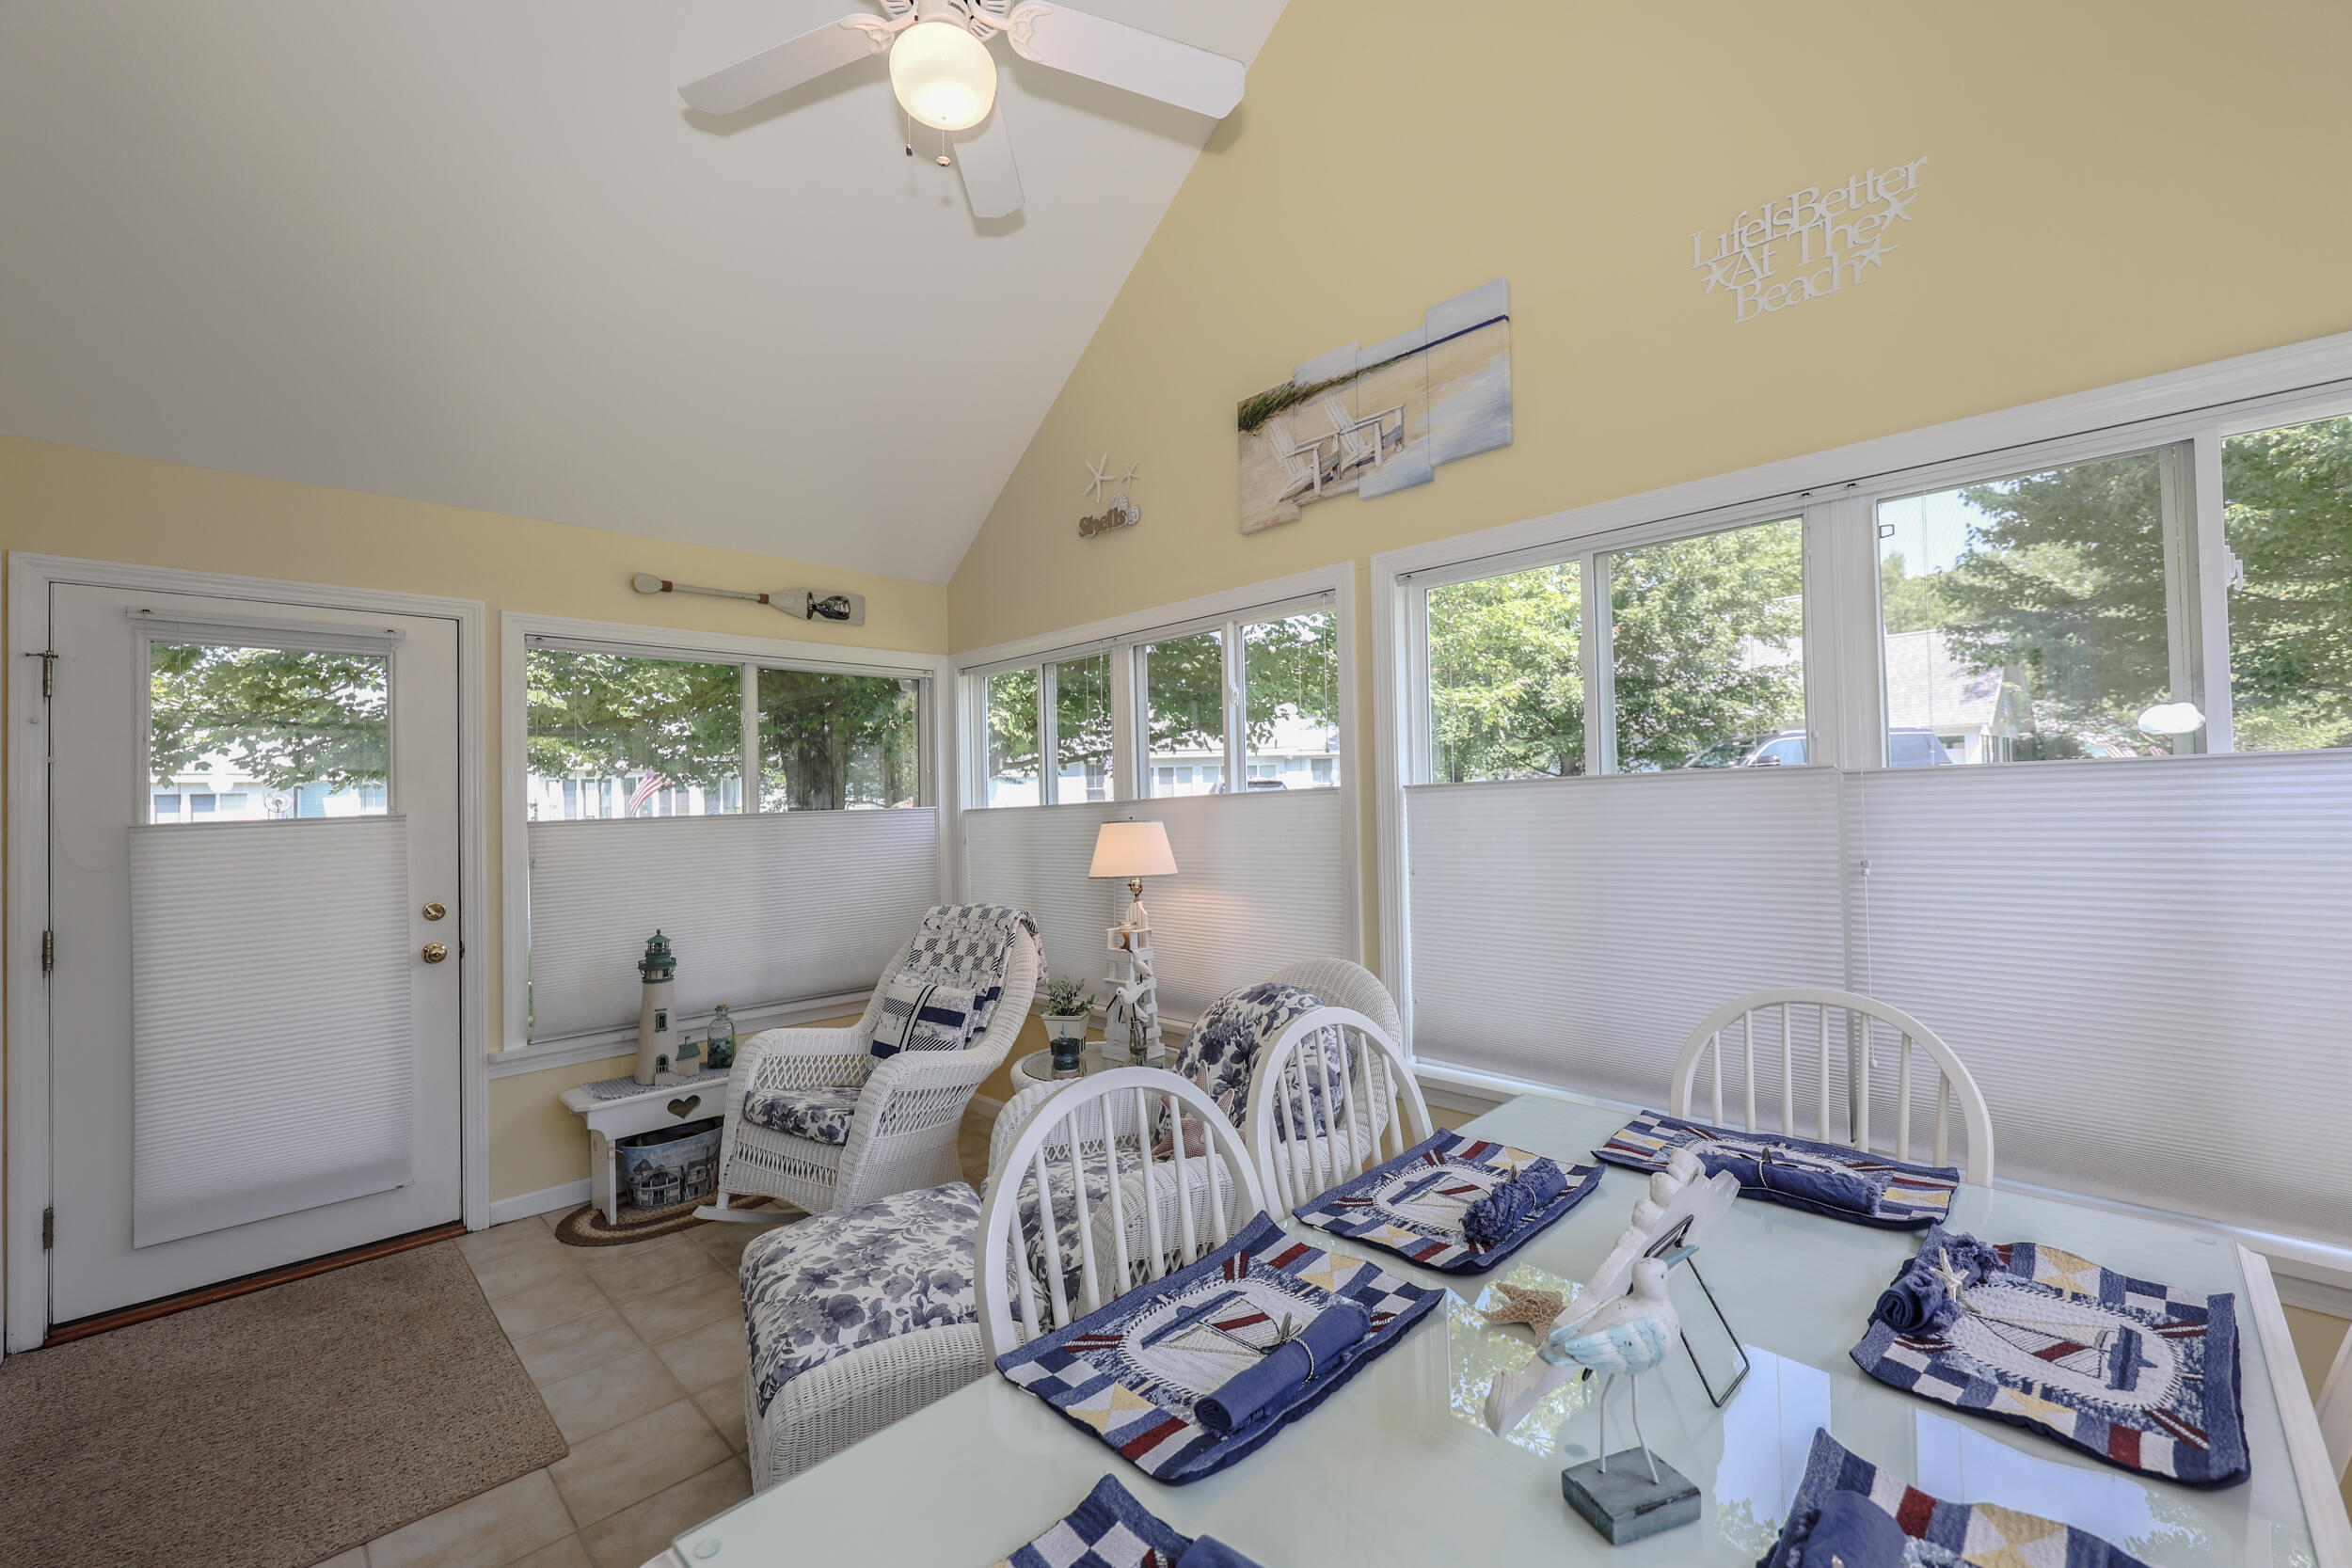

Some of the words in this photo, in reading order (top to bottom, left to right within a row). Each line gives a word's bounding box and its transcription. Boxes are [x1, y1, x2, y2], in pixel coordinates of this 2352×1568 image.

[1724, 243, 1777, 291] At
[1787, 213, 1883, 267] The
[1725, 250, 1867, 323] Beach
